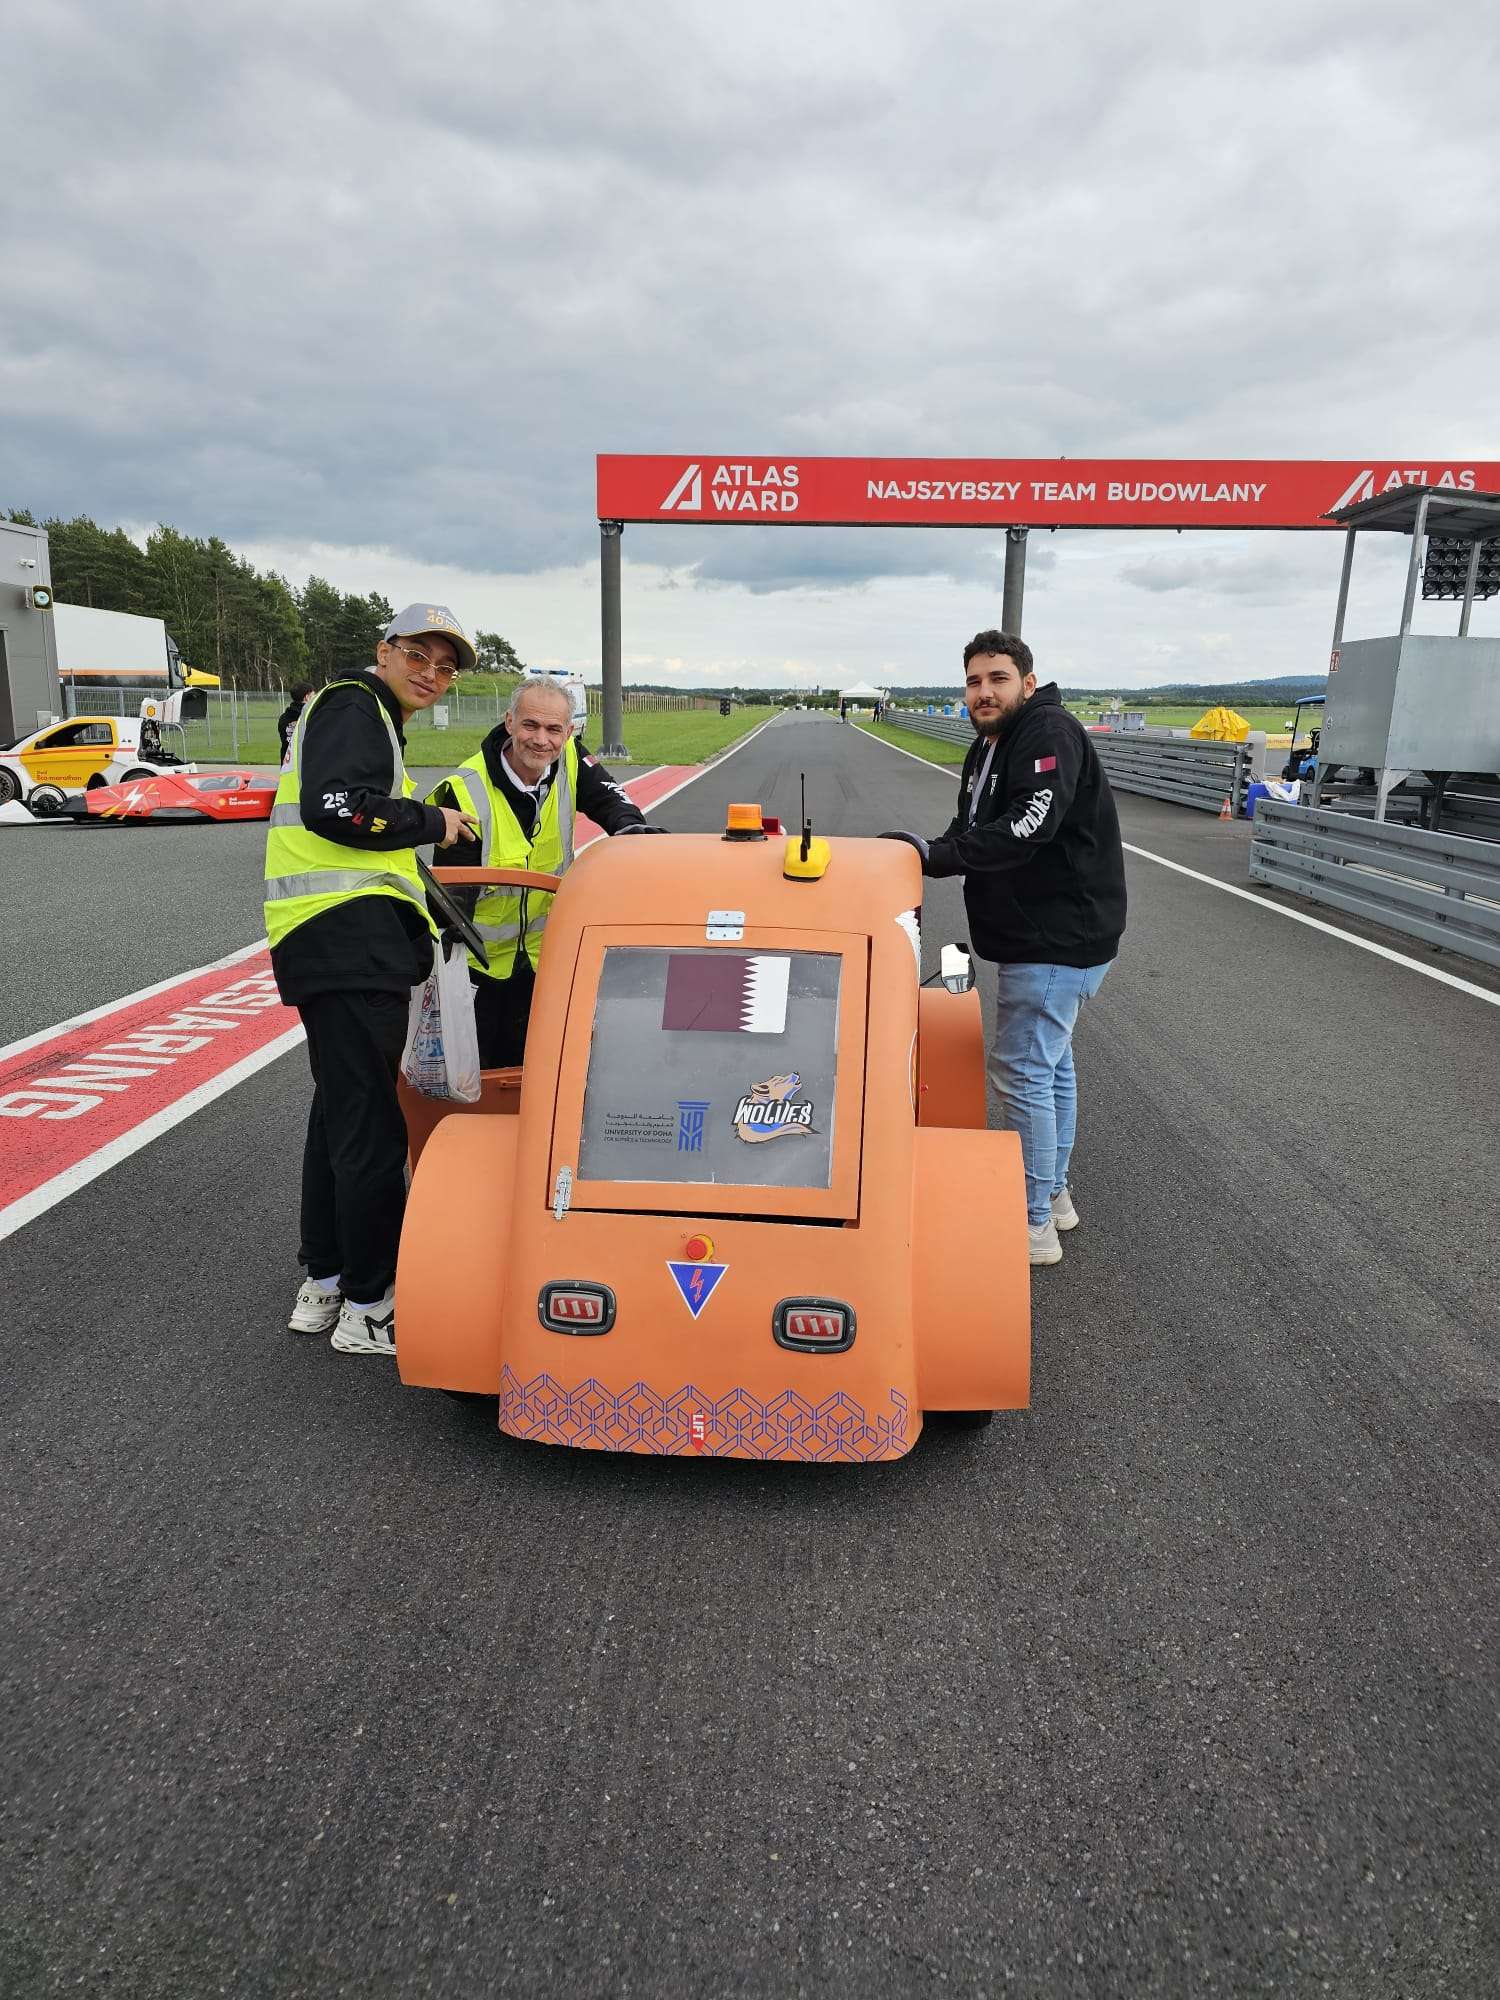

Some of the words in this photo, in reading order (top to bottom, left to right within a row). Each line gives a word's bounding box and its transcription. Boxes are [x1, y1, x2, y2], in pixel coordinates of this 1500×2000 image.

[711, 465, 799, 487] ATLAS
[711, 490, 799, 511] WARD
[867, 480, 1021, 501] NAJSZYBSZY
[1030, 482, 1096, 501] TEAM
[1107, 482, 1267, 502] BUDOWLANY
[733, 1097, 813, 1125] WOLVES
[692, 1414, 704, 1440] LIFT
